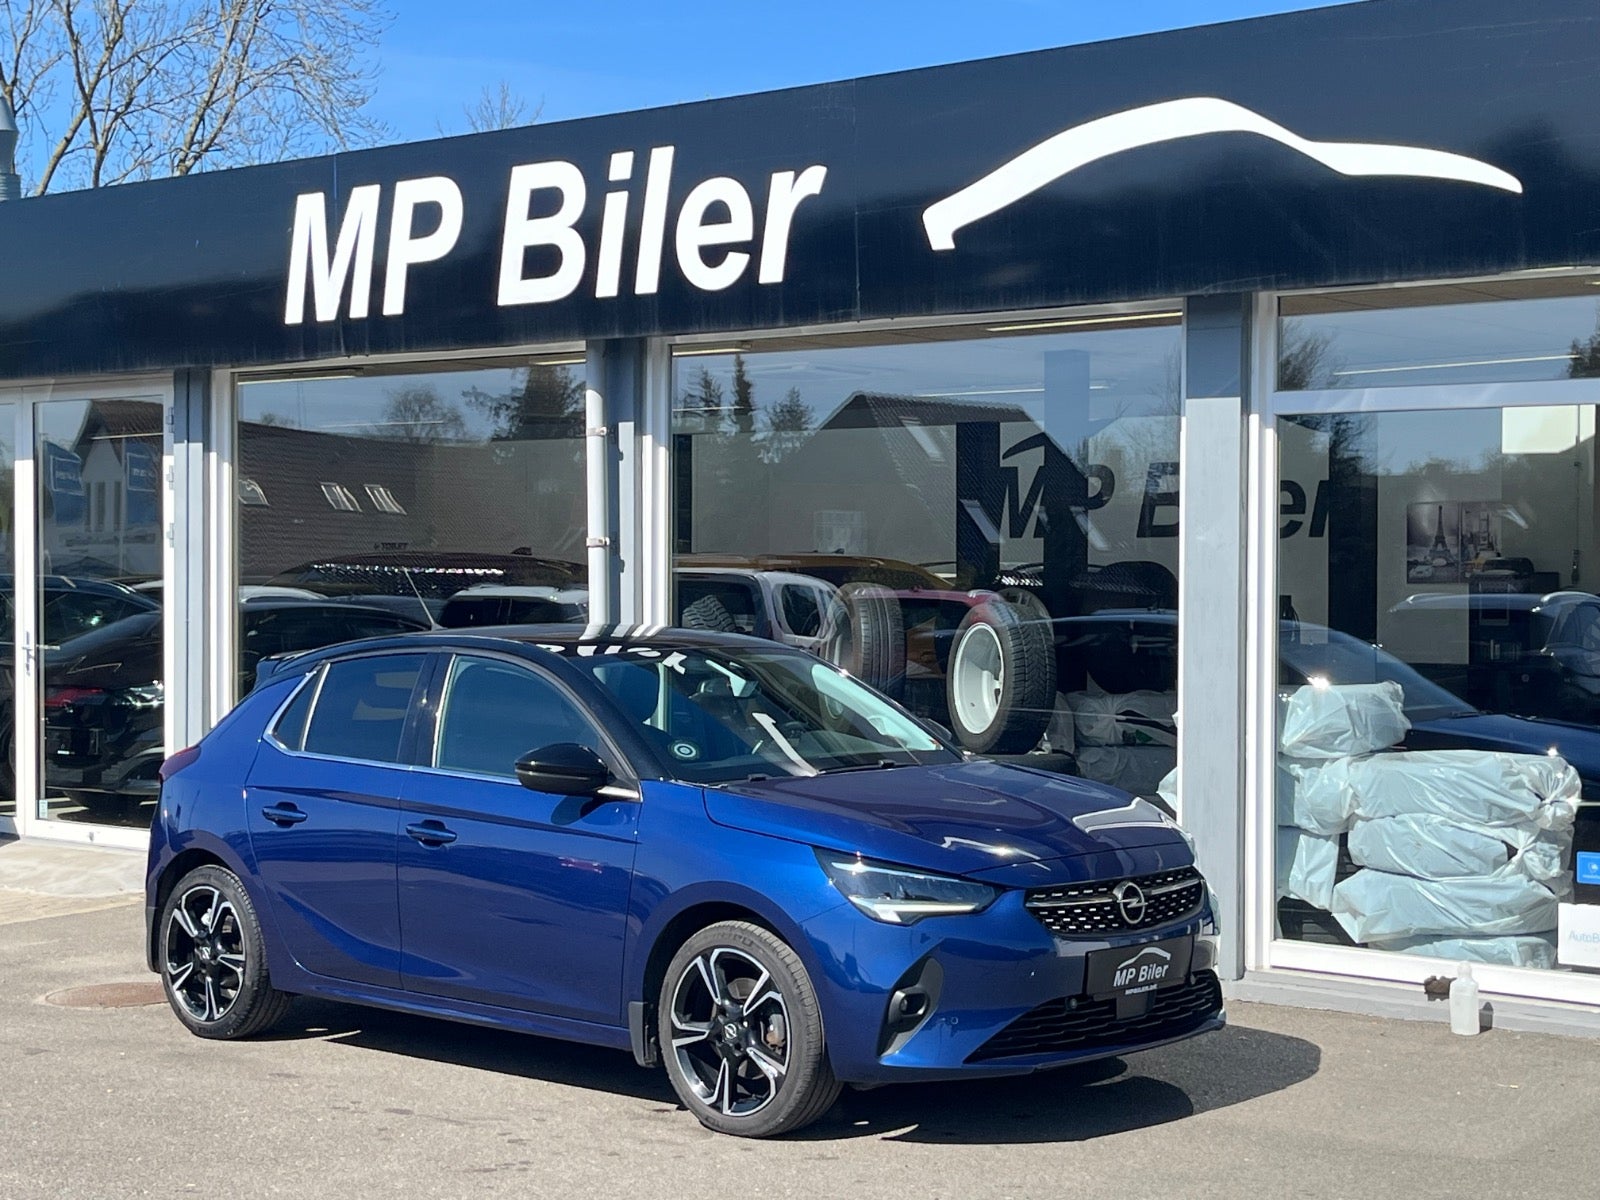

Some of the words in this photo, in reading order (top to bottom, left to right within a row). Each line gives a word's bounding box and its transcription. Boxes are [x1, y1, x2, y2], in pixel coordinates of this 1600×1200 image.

[283, 176, 464, 325] MP
[497, 145, 827, 306] Biler
[1112, 967, 1136, 987] MP
[1137, 963, 1169, 983] Biler
